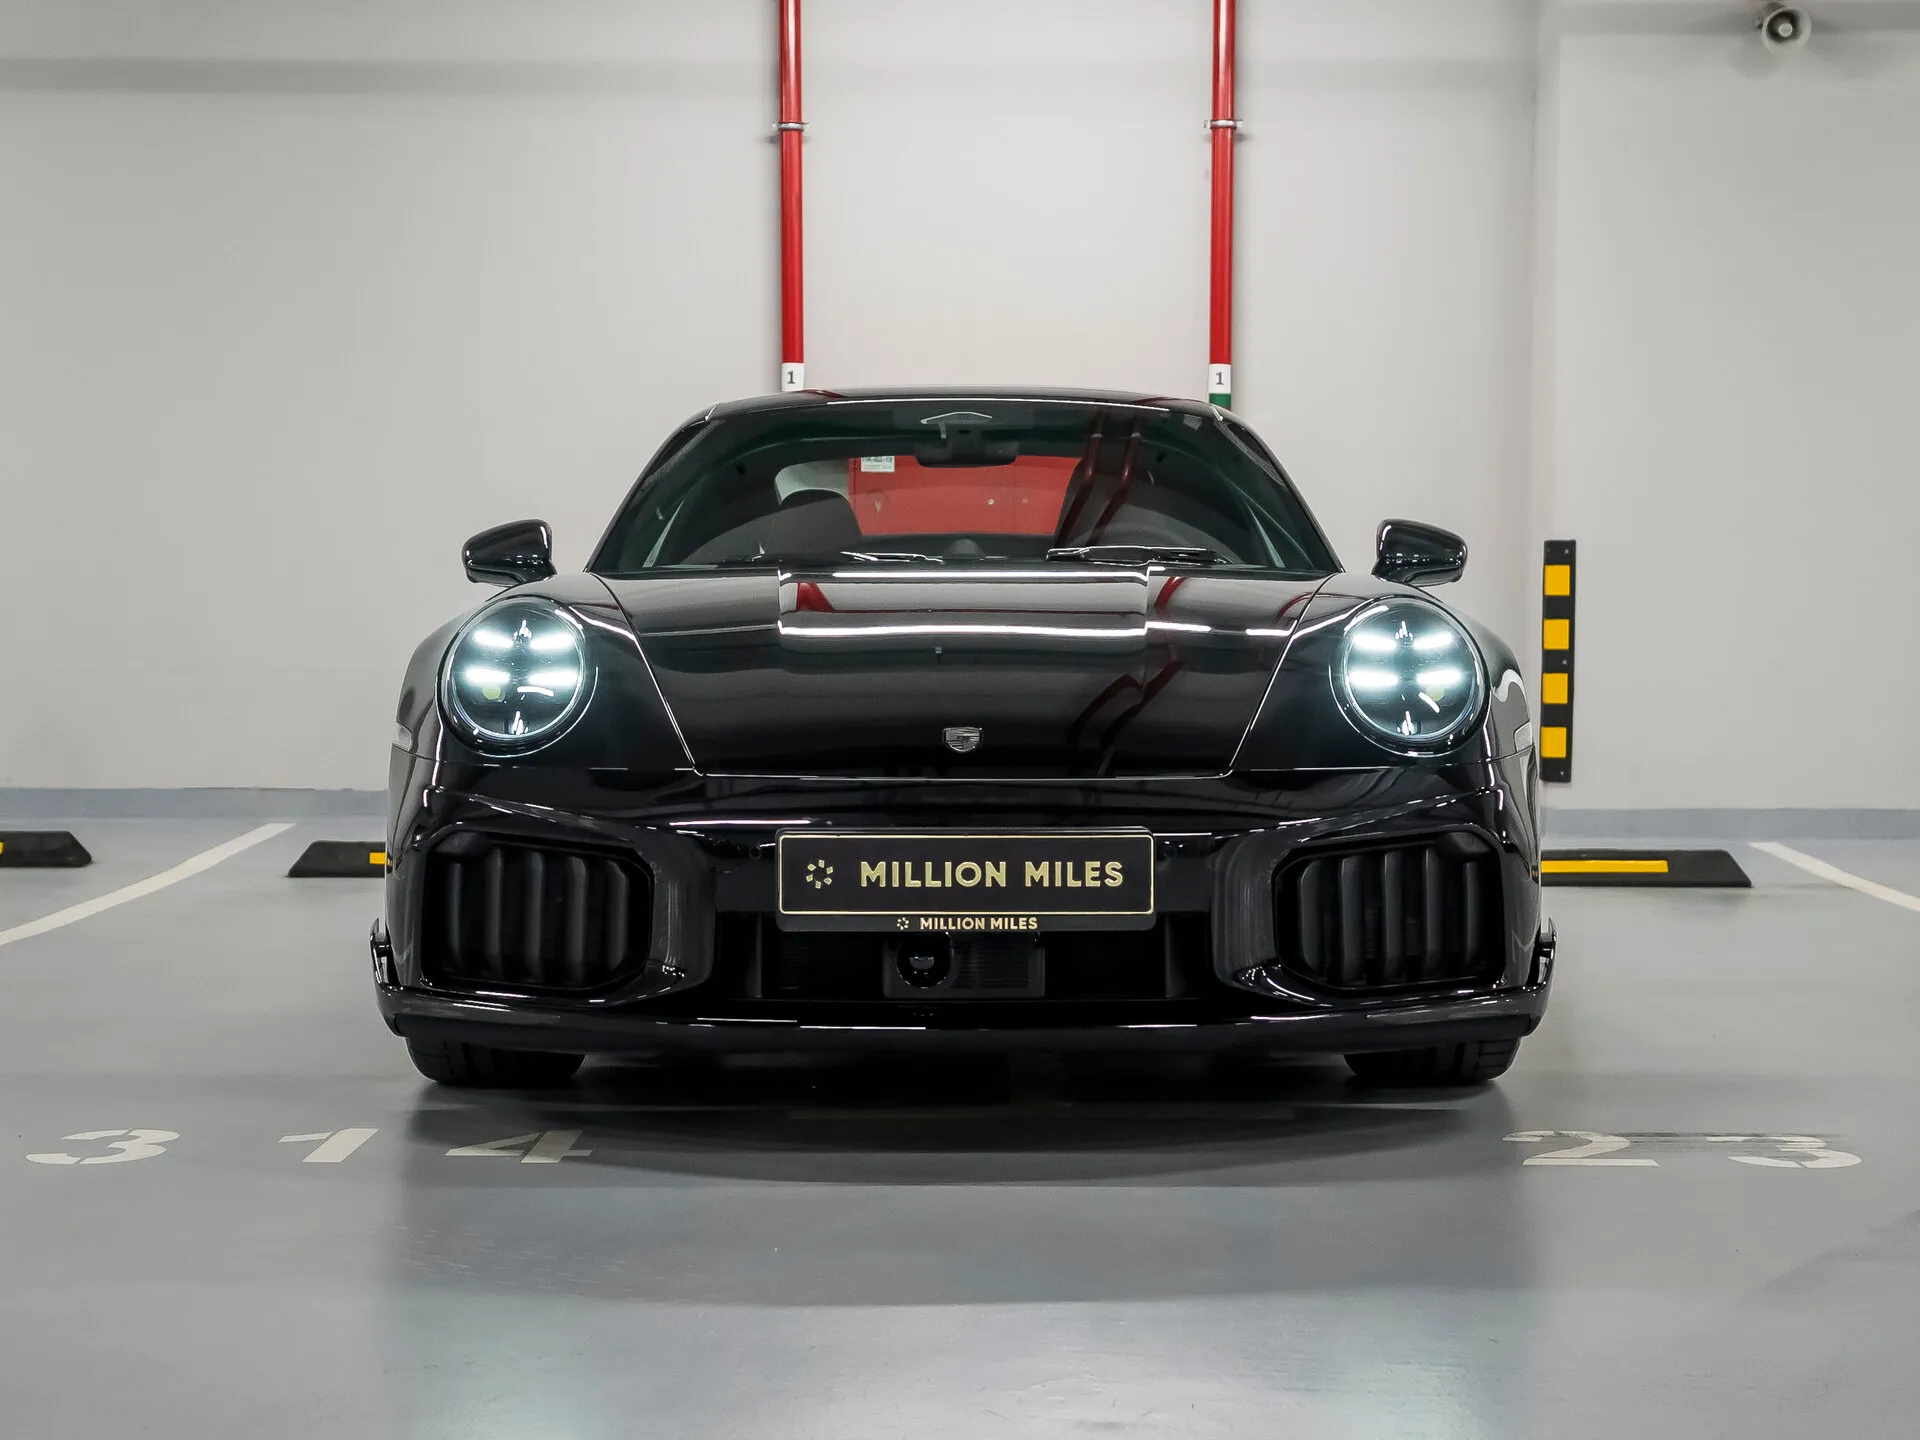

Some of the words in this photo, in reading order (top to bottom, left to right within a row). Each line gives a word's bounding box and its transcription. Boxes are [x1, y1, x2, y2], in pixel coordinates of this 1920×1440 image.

[787, 370, 796, 384] 1
[1215, 371, 1225, 385] 1
[860, 861, 1007, 888] MILLION
[1024, 861, 1124, 888] MILES
[919, 917, 985, 930] MILLION
[990, 917, 1038, 930] MILES
